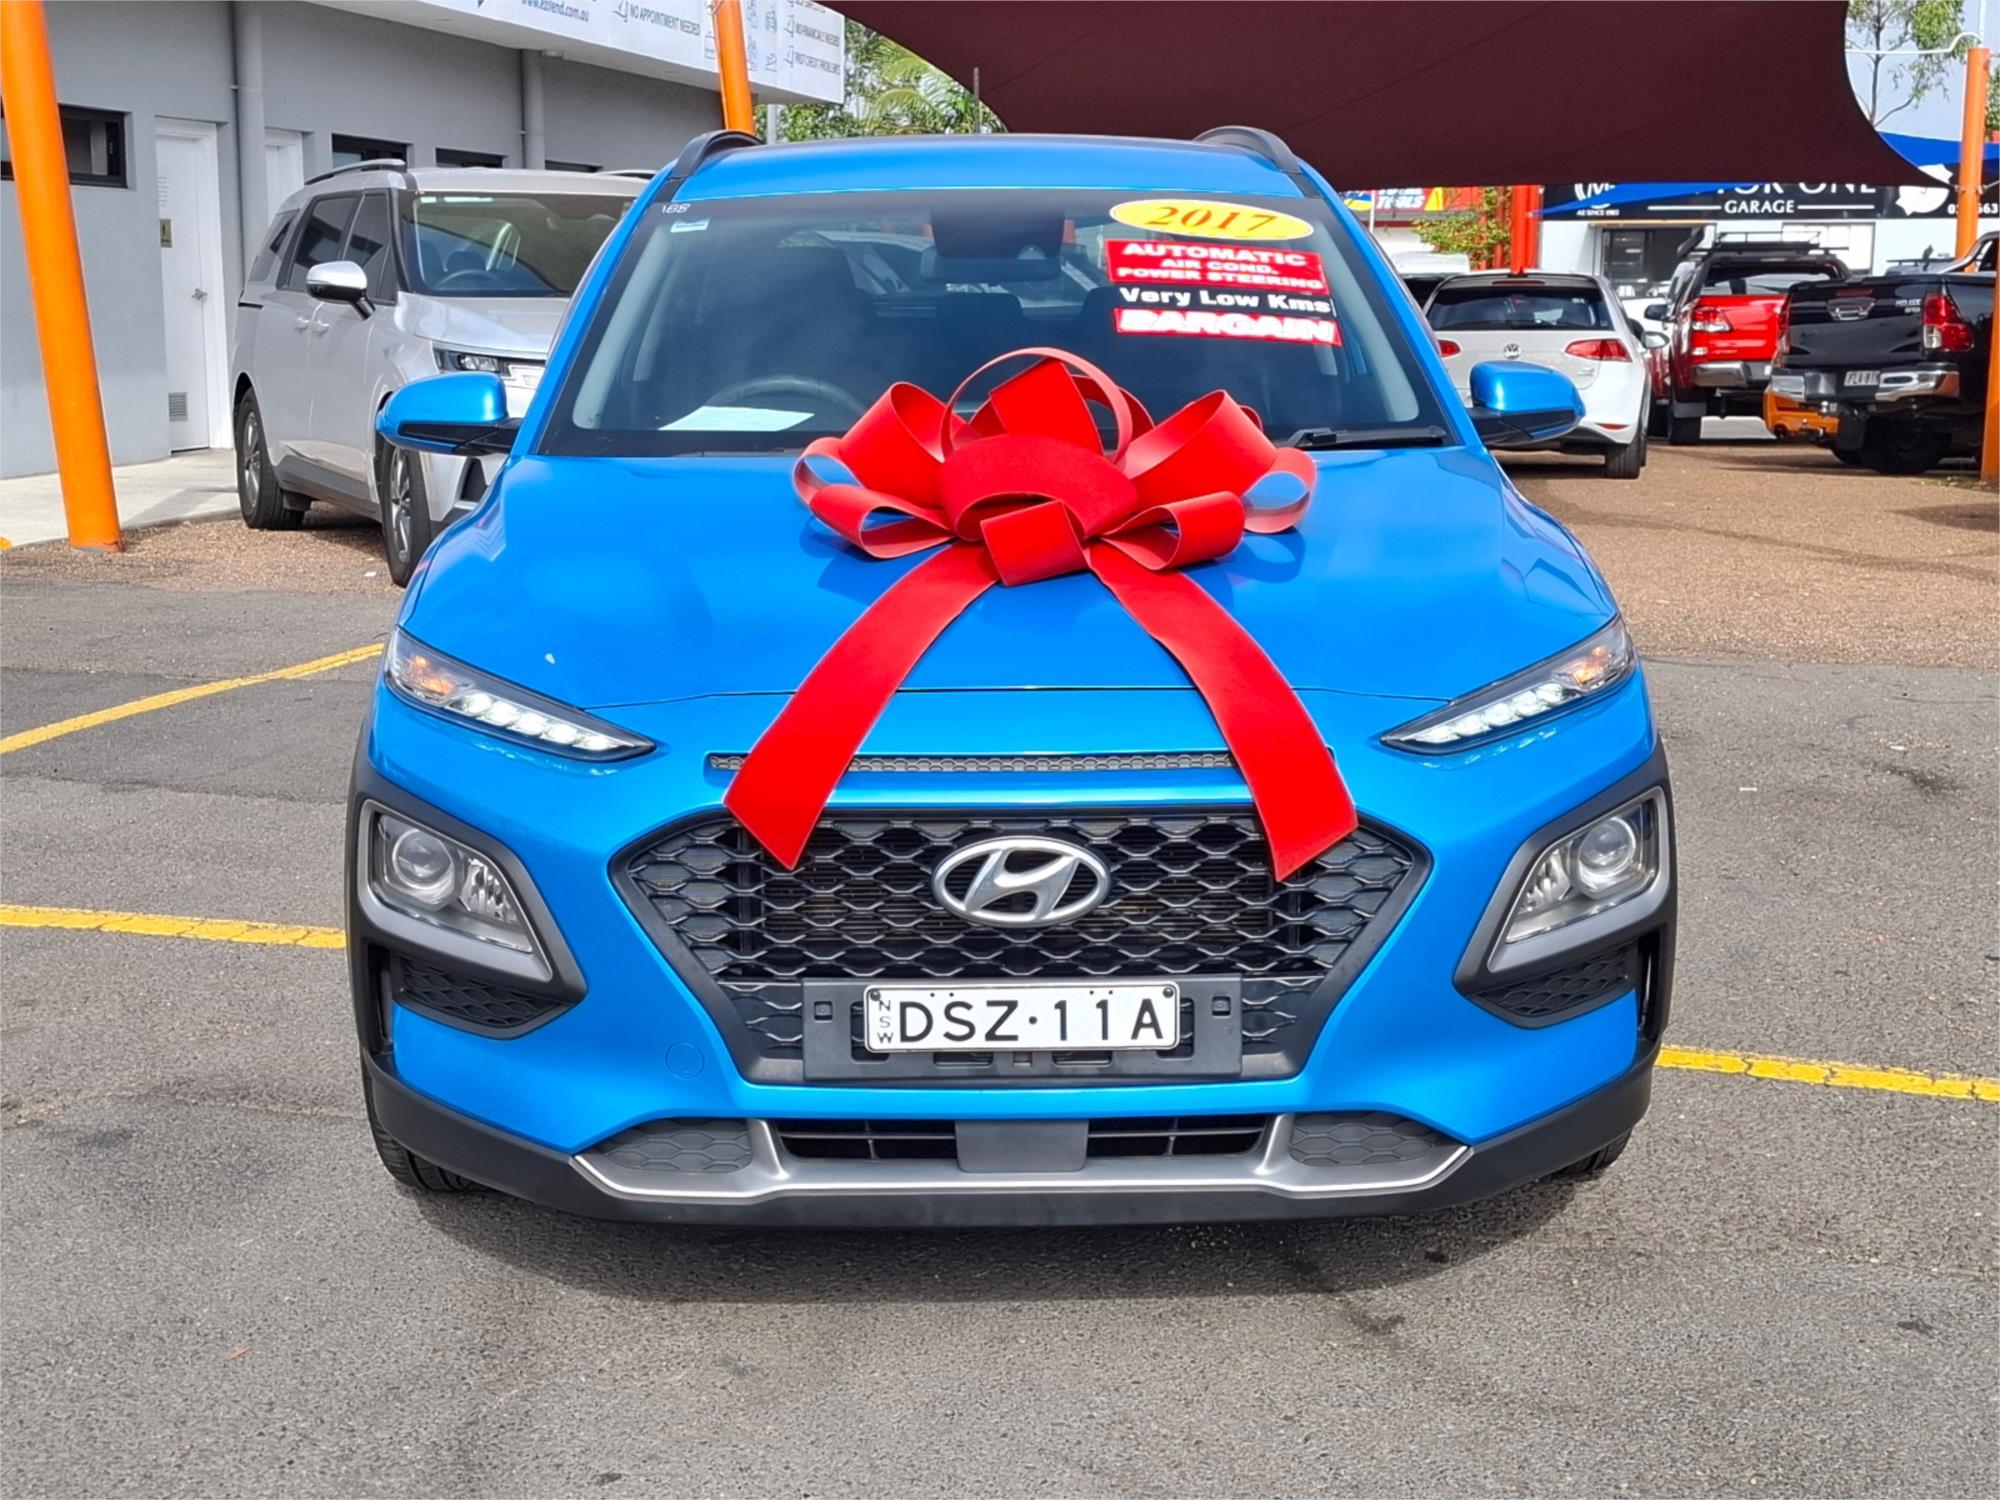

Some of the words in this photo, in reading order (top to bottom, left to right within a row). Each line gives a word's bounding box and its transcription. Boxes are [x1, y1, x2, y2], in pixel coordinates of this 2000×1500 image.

[630, 4, 639, 19] NO
[640, 7, 679, 30] APPOINTMENT
[1724, 200, 1794, 213] GARAGE
[1146, 207, 1278, 232] 2017
[1122, 243, 1307, 266] AUTOMATIC
[1160, 258, 1201, 269] AIR
[1207, 261, 1279, 275] COND.
[1116, 268, 1202, 280] POWER
[1207, 272, 1324, 290] STEERING
[1119, 287, 1191, 307] Very
[1201, 290, 1259, 308] Low
[1268, 294, 1331, 313] Kms
[1119, 309, 1338, 343] BARGAIN
[876, 999, 894, 1044] NSW
